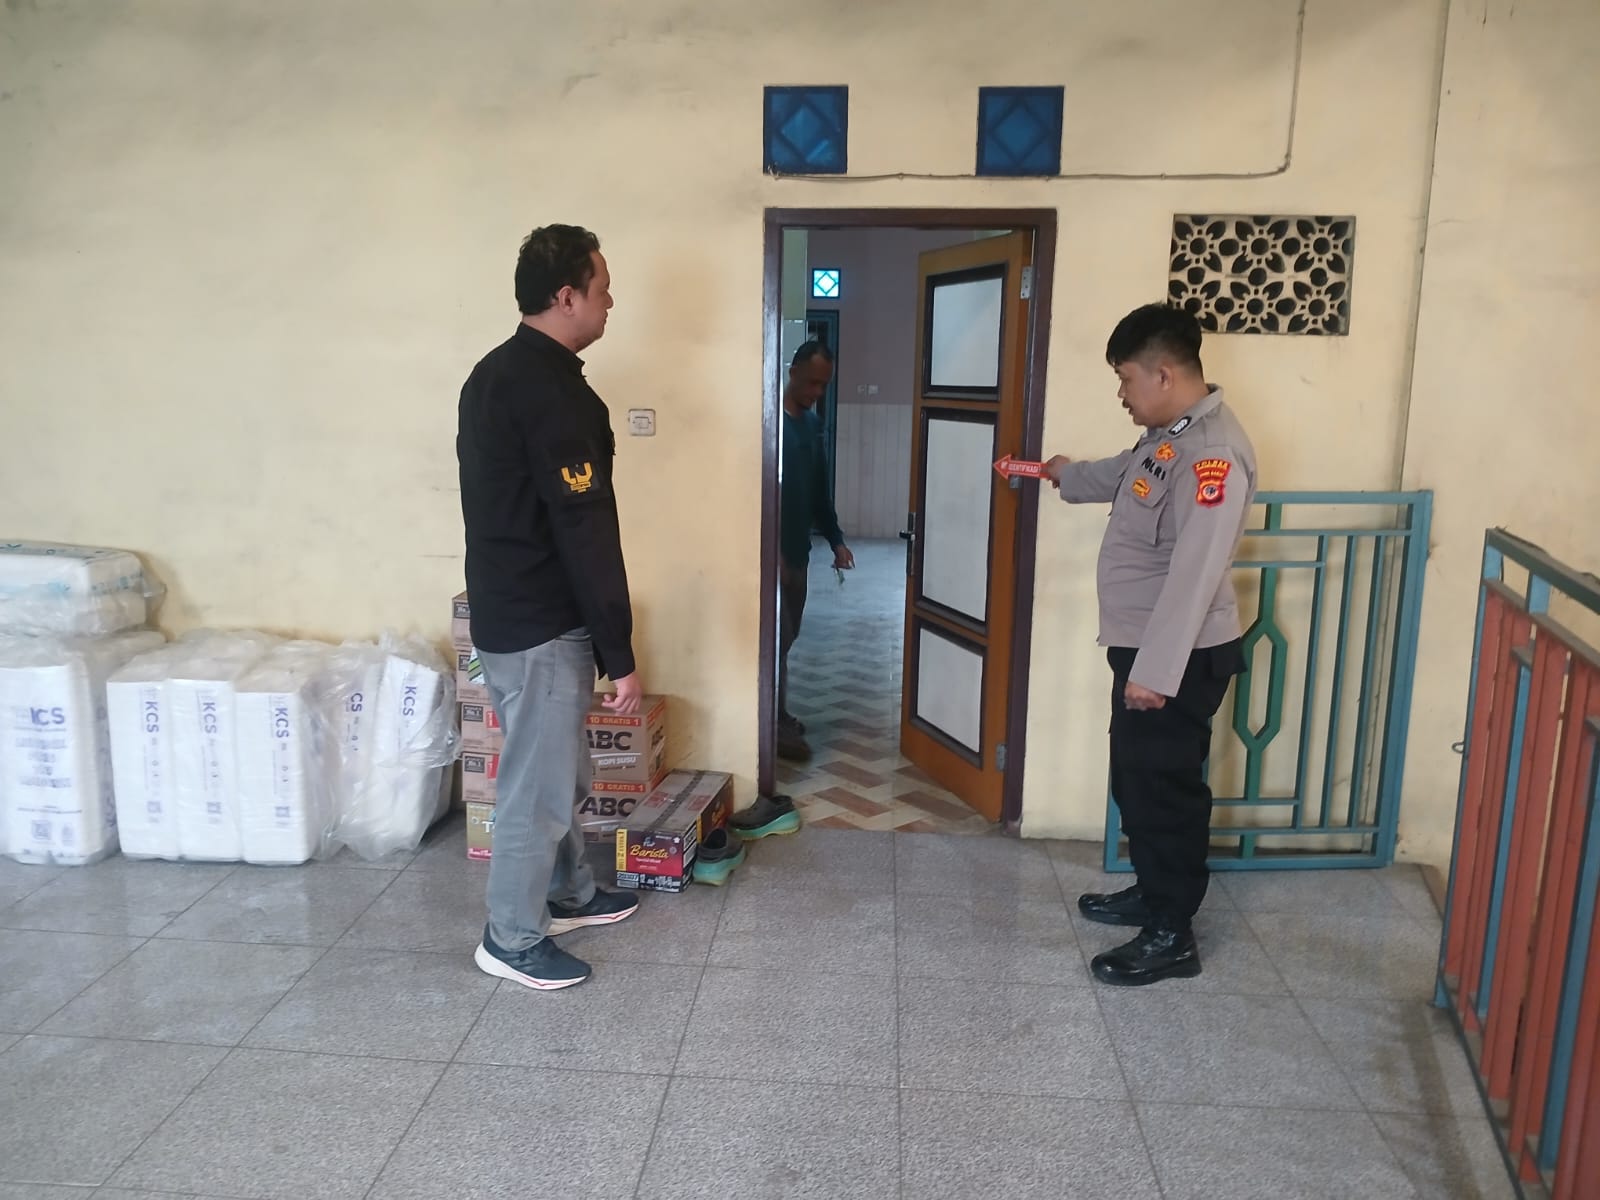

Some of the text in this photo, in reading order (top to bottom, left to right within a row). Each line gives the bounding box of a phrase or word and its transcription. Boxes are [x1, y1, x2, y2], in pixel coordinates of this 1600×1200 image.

[350, 692, 363, 712] CS
[402, 686, 417, 716] KCS
[144, 701, 159, 733] KCS
[202, 702, 217, 734] KCS
[274, 707, 289, 739] KCS
[602, 717, 631, 726] GRATIS
[607, 784, 635, 792] GRATIS
[578, 796, 637, 817] ABC
[630, 844, 669, 859] Barista
